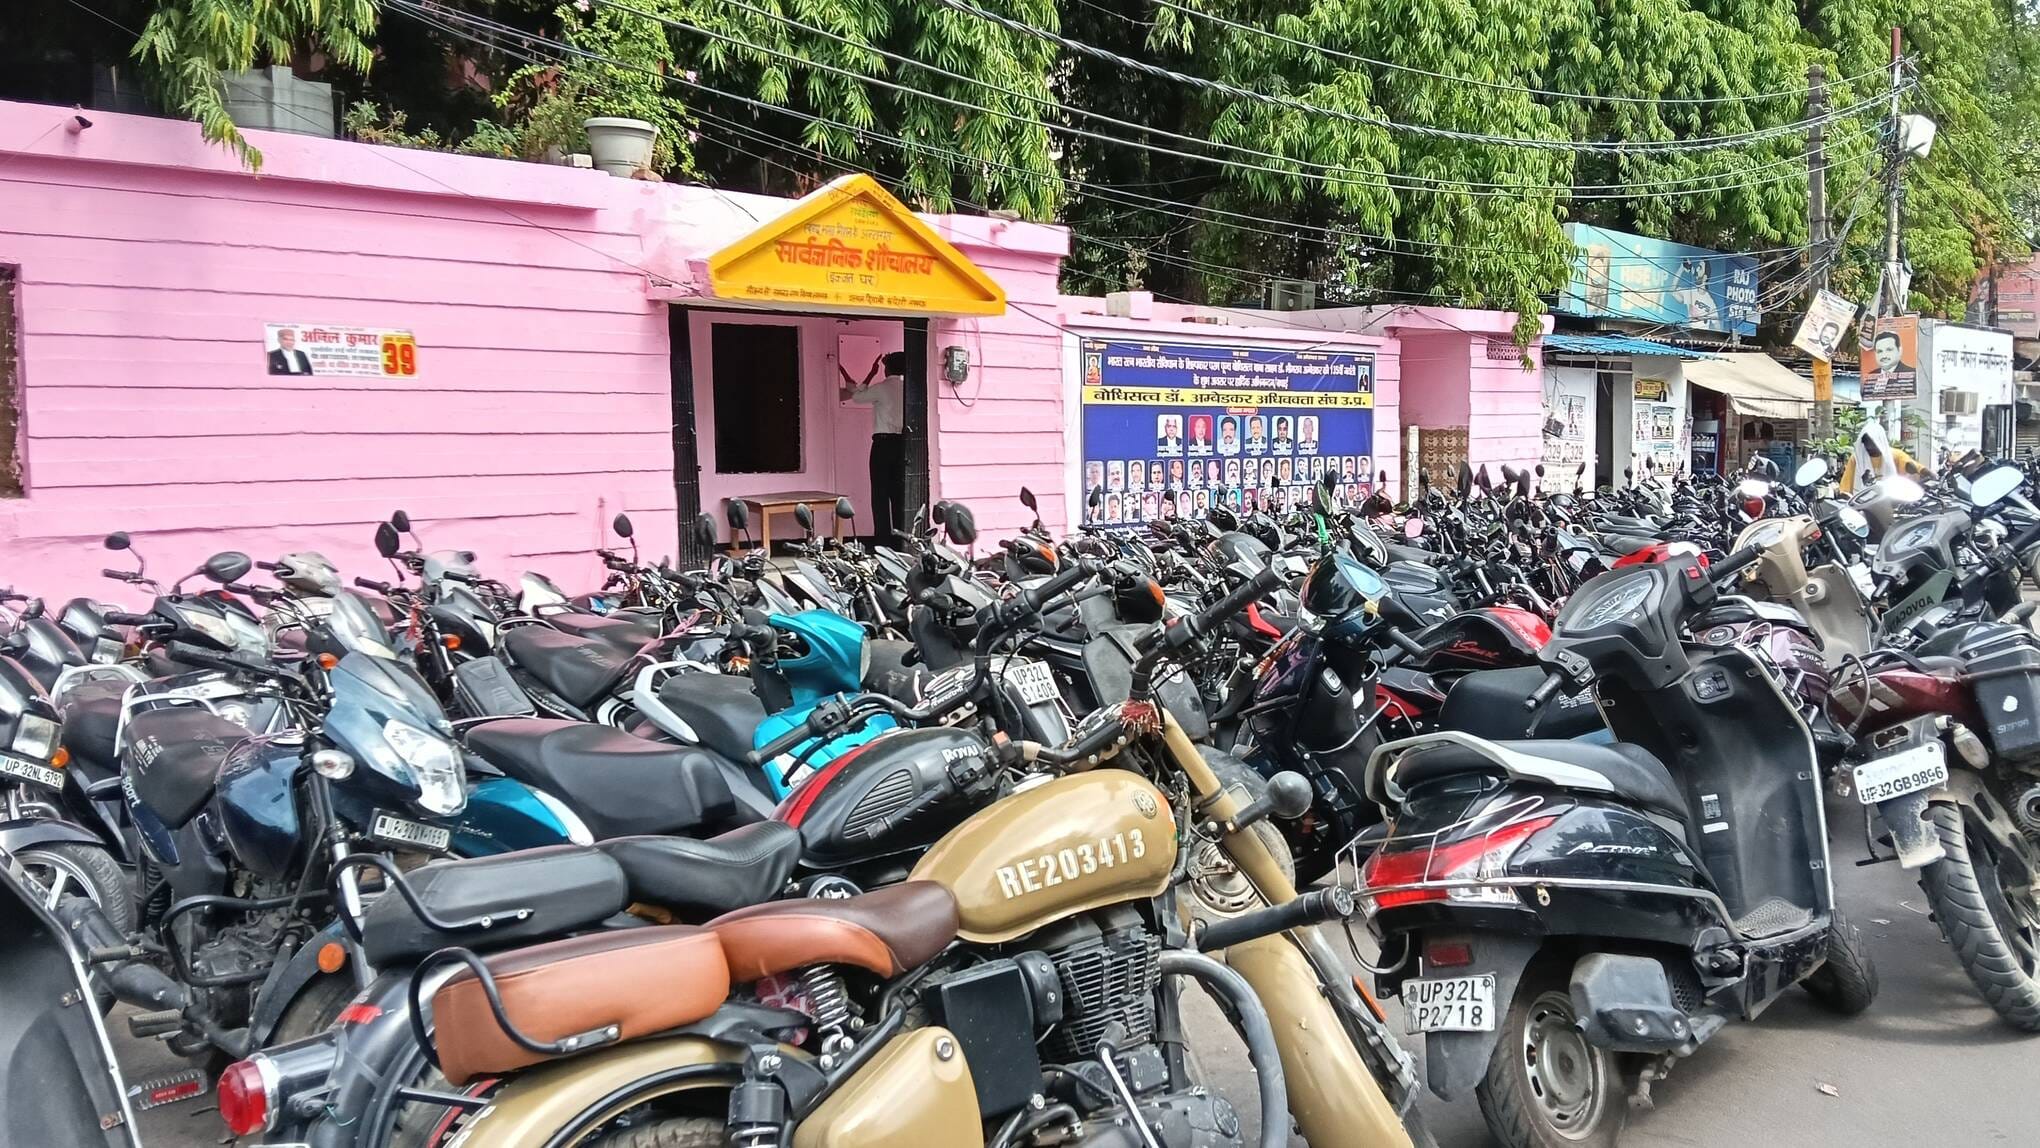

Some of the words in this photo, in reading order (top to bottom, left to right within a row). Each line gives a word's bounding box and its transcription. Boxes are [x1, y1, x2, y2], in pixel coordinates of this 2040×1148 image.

[775, 236, 863, 268] सार्वजनिक
[865, 243, 939, 275] शौचालय
[1734, 269, 1750, 286] RAJ
[1727, 286, 1756, 304] PHOTO
[301, 328, 340, 344] अनिल
[344, 333, 379, 347] कुमार
[383, 343, 415, 375] 39
[1093, 388, 1160, 402] बोधिसत्व
[1166, 389, 1185, 402] डॉ.
[1191, 391, 1253, 404] अम्बेडकर
[1256, 392, 1313, 405] अधिवक्ता
[1317, 393, 1337, 405] संघ
[1013, 665, 1048, 685] UP32L
[5, 759, 20, 772] UP
[22, 764, 41, 780] 32NL
[995, 828, 1145, 900] RE203413
[1421, 980, 1483, 1003] UP32L
[1420, 1005, 1483, 1029] P2718
